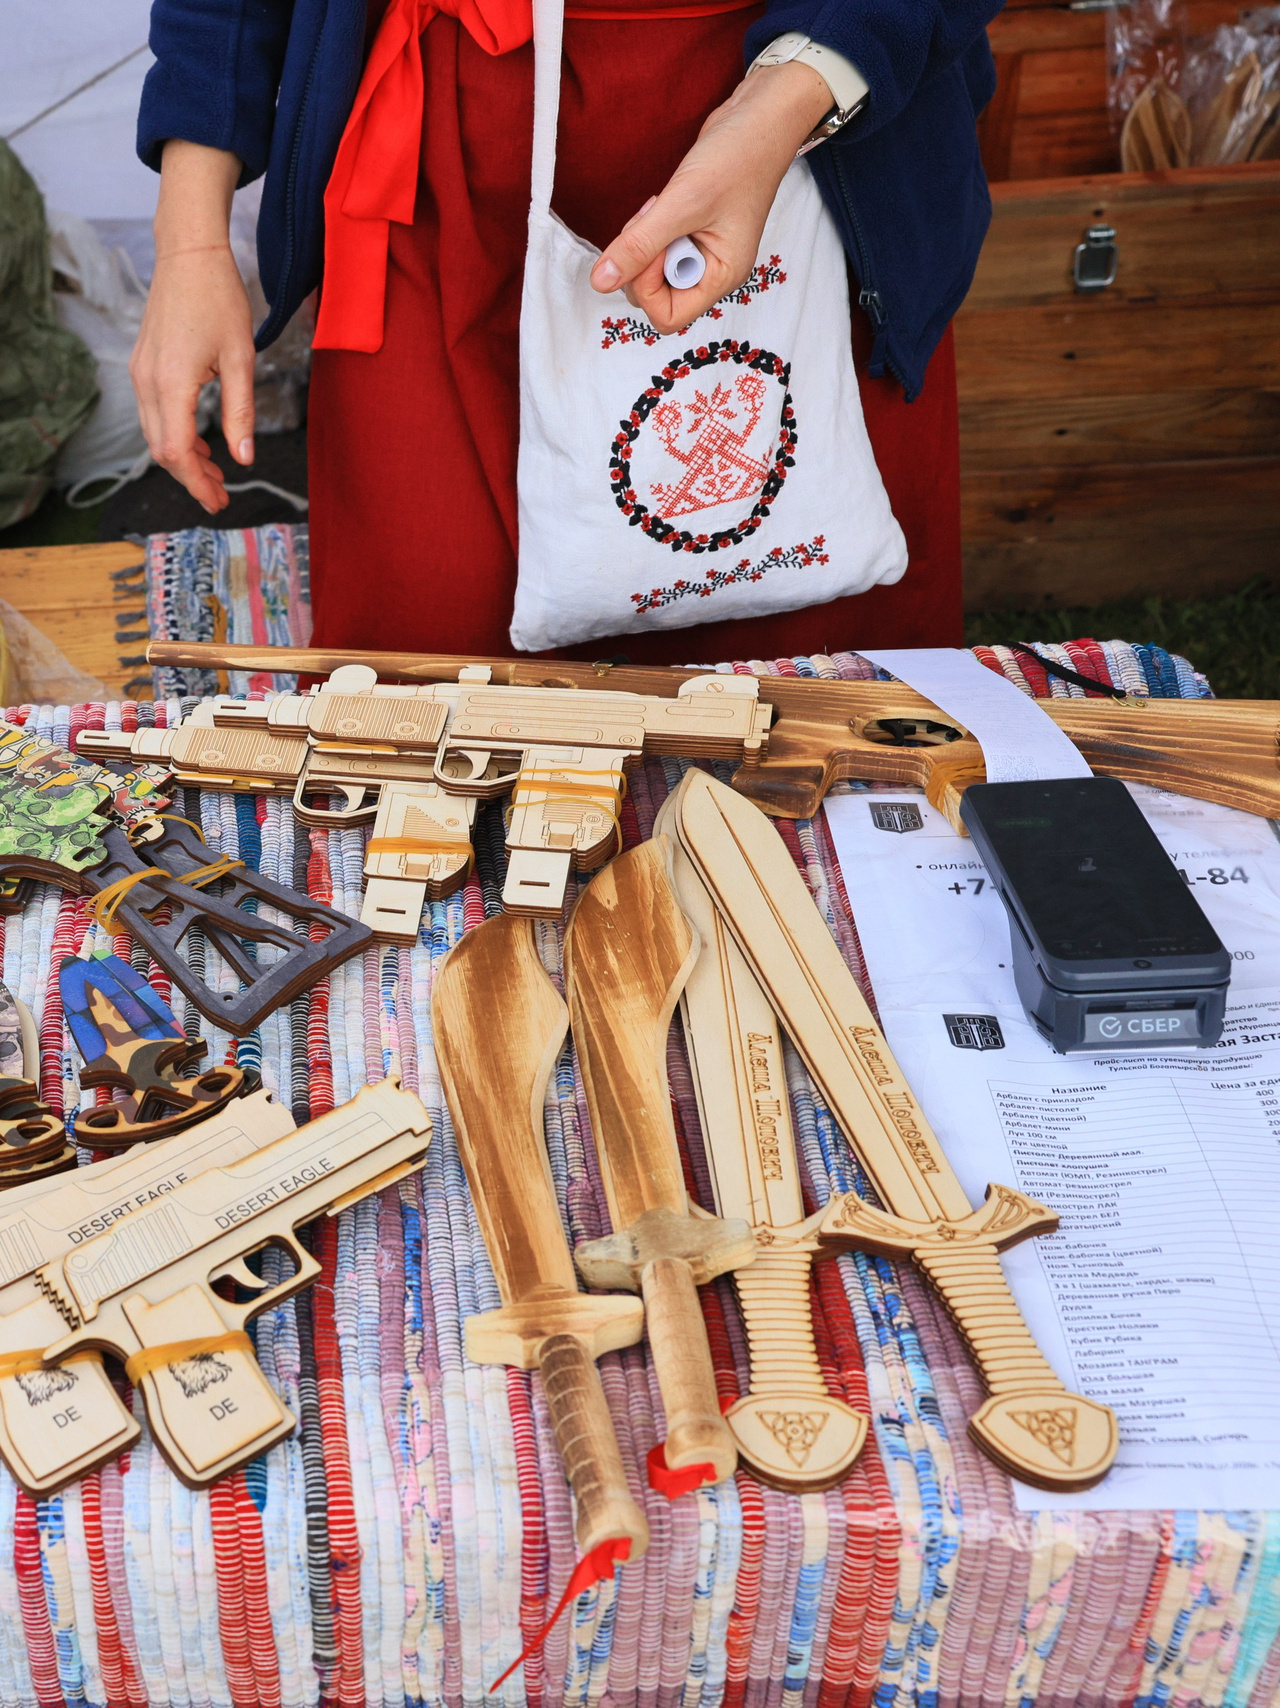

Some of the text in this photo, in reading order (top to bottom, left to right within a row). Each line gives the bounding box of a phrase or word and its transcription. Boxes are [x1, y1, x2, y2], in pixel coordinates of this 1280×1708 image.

[1128, 1018, 1181, 1033] СБЕР
[1224, 1017, 1258, 1026] ратство
[1094, 1057, 1145, 1066] Прайс-лист
[1160, 1057, 1210, 1065] сувенирную
[1212, 1053, 1263, 1065] продукцию
[1108, 1064, 1148, 1072] Тульской
[1150, 1064, 1208, 1072] Богатырской
[1051, 1085, 1107, 1094] Название
[1210, 1082, 1241, 1091] Цена
[1256, 1089, 1274, 1097] 400
[996, 1092, 1032, 1102] Арбалет
[1041, 1096, 1095, 1104] прикладом
[1260, 1099, 1278, 1107] 300
[999, 1102, 1080, 1112] Арбалет-пистолет
[1002, 1111, 1039, 1120] Арбалет
[1005, 1120, 1071, 1131] Арбалет-мини
[882, 1091, 941, 1175] Попович
[1027, 1131, 1043, 1139] 100
[755, 1099, 783, 1181] Попович
[1030, 1141, 1068, 1150] цветной
[1013, 1150, 1056, 1158] Пистолет
[1058, 1152, 1120, 1161] Деревянный
[1016, 1160, 1059, 1168] Пистолет
[1020, 1170, 1059, 1178] Автомат
[1096, 1167, 1167, 1179] Резинкострел)
[1023, 1180, 1132, 1189] Автомат-резинкострел
[215, 1157, 337, 1231] DESERT EAGLE
[1046, 1190, 1120, 1200] (Резинкострел)
[1046, 1203, 1094, 1211] инкострел
[1060, 1211, 1120, 1221] кострел БЕЛ
[67, 1201, 133, 1245] DESERT
[1040, 1242, 1107, 1251] Нож-бабочка
[1043, 1251, 1110, 1261] Нож-бабочка
[210, 1397, 239, 1421] DE
[53, 1406, 82, 1428] DE
